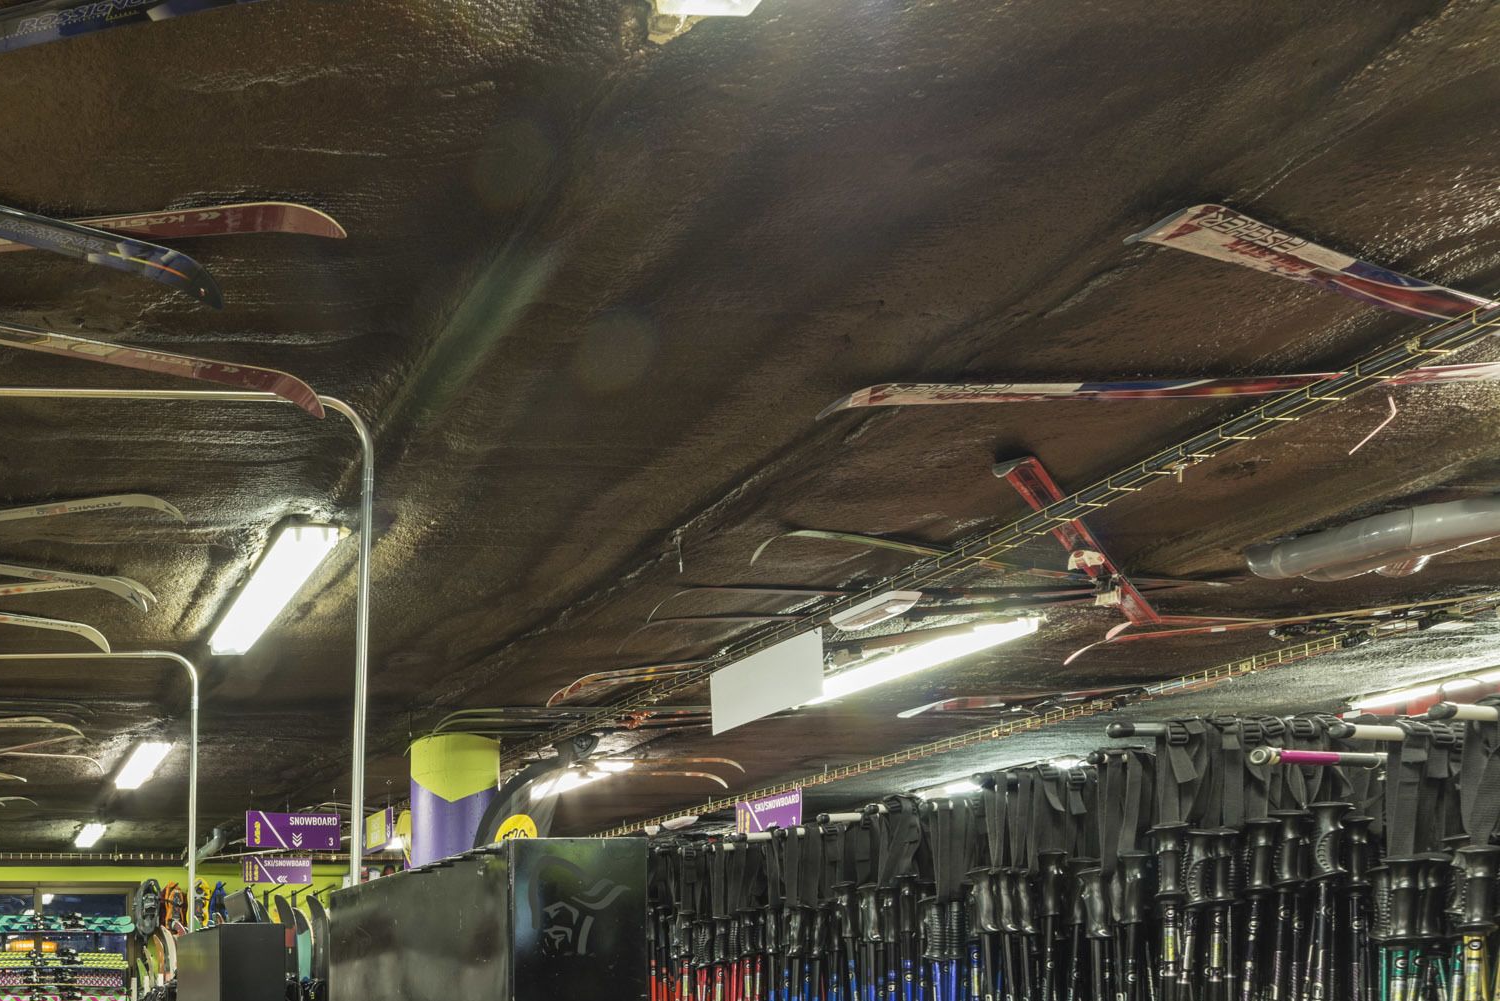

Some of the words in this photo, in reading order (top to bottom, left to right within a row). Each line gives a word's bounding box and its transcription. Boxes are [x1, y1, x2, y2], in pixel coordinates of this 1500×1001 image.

[1198, 211, 1309, 253] FISCHER
[289, 816, 338, 827] SNOWBOARD
[328, 837, 335, 847] 3
[263, 859, 310, 868] SKI/SNOWBOARD
